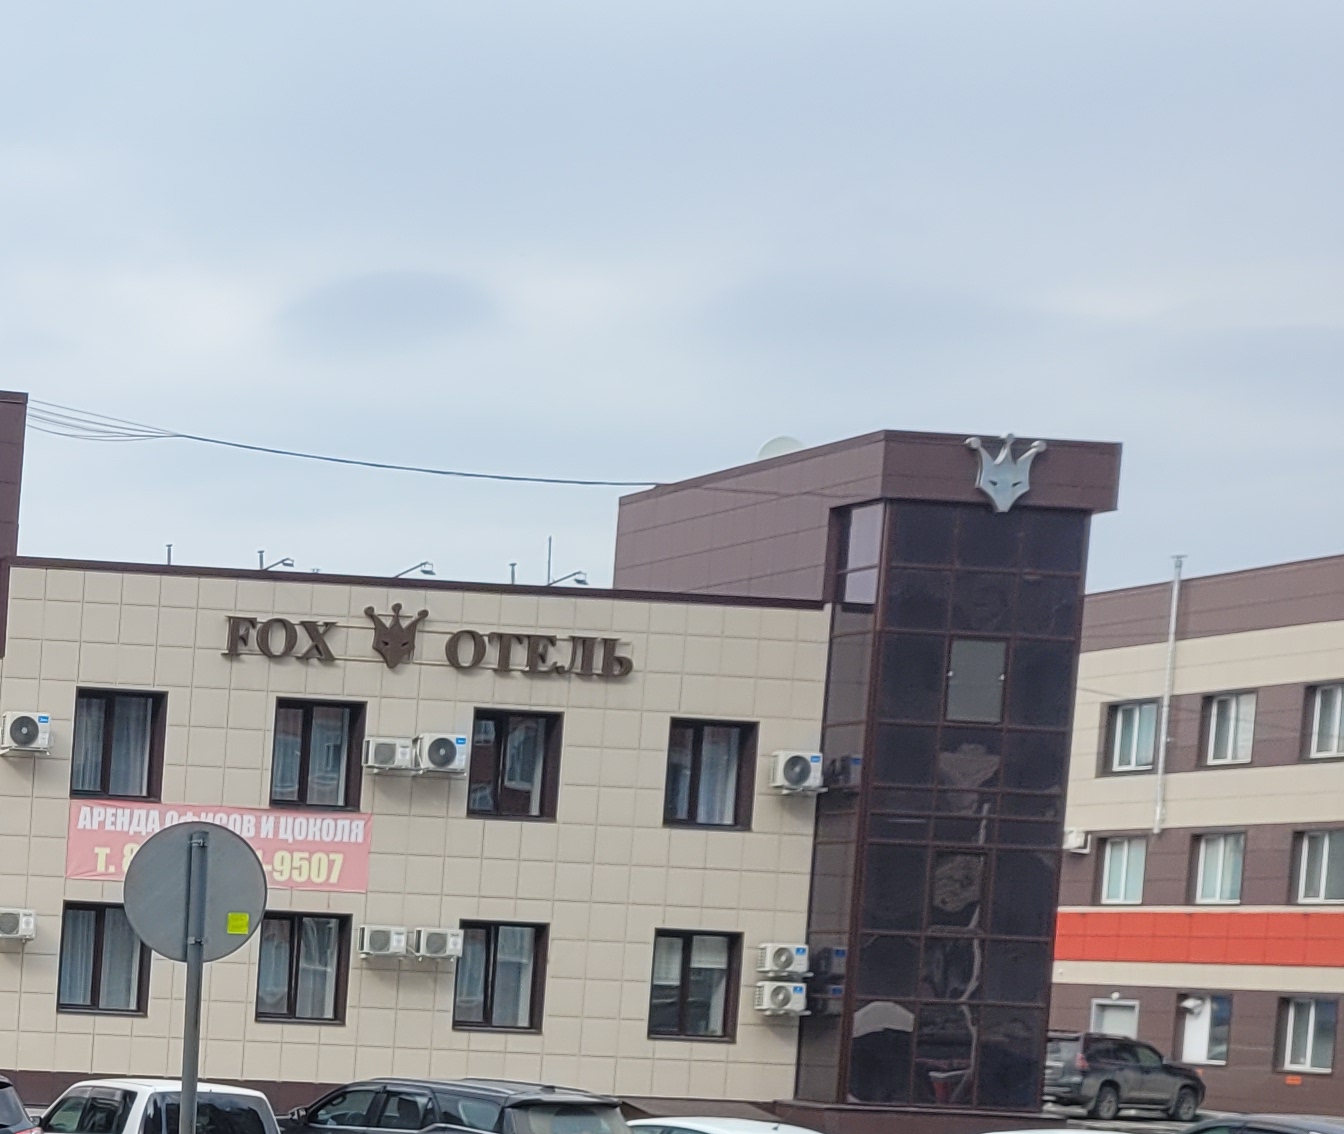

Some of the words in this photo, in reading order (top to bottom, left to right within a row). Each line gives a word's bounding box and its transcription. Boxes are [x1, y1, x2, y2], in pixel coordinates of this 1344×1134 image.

[221, 615, 339, 661] FOX
[445, 629, 634, 678] ОТЕЛЬ
[77, 805, 160, 836] АРЕНДА
[260, 814, 275, 839] И
[277, 816, 365, 844] ЦОКОЛЯ
